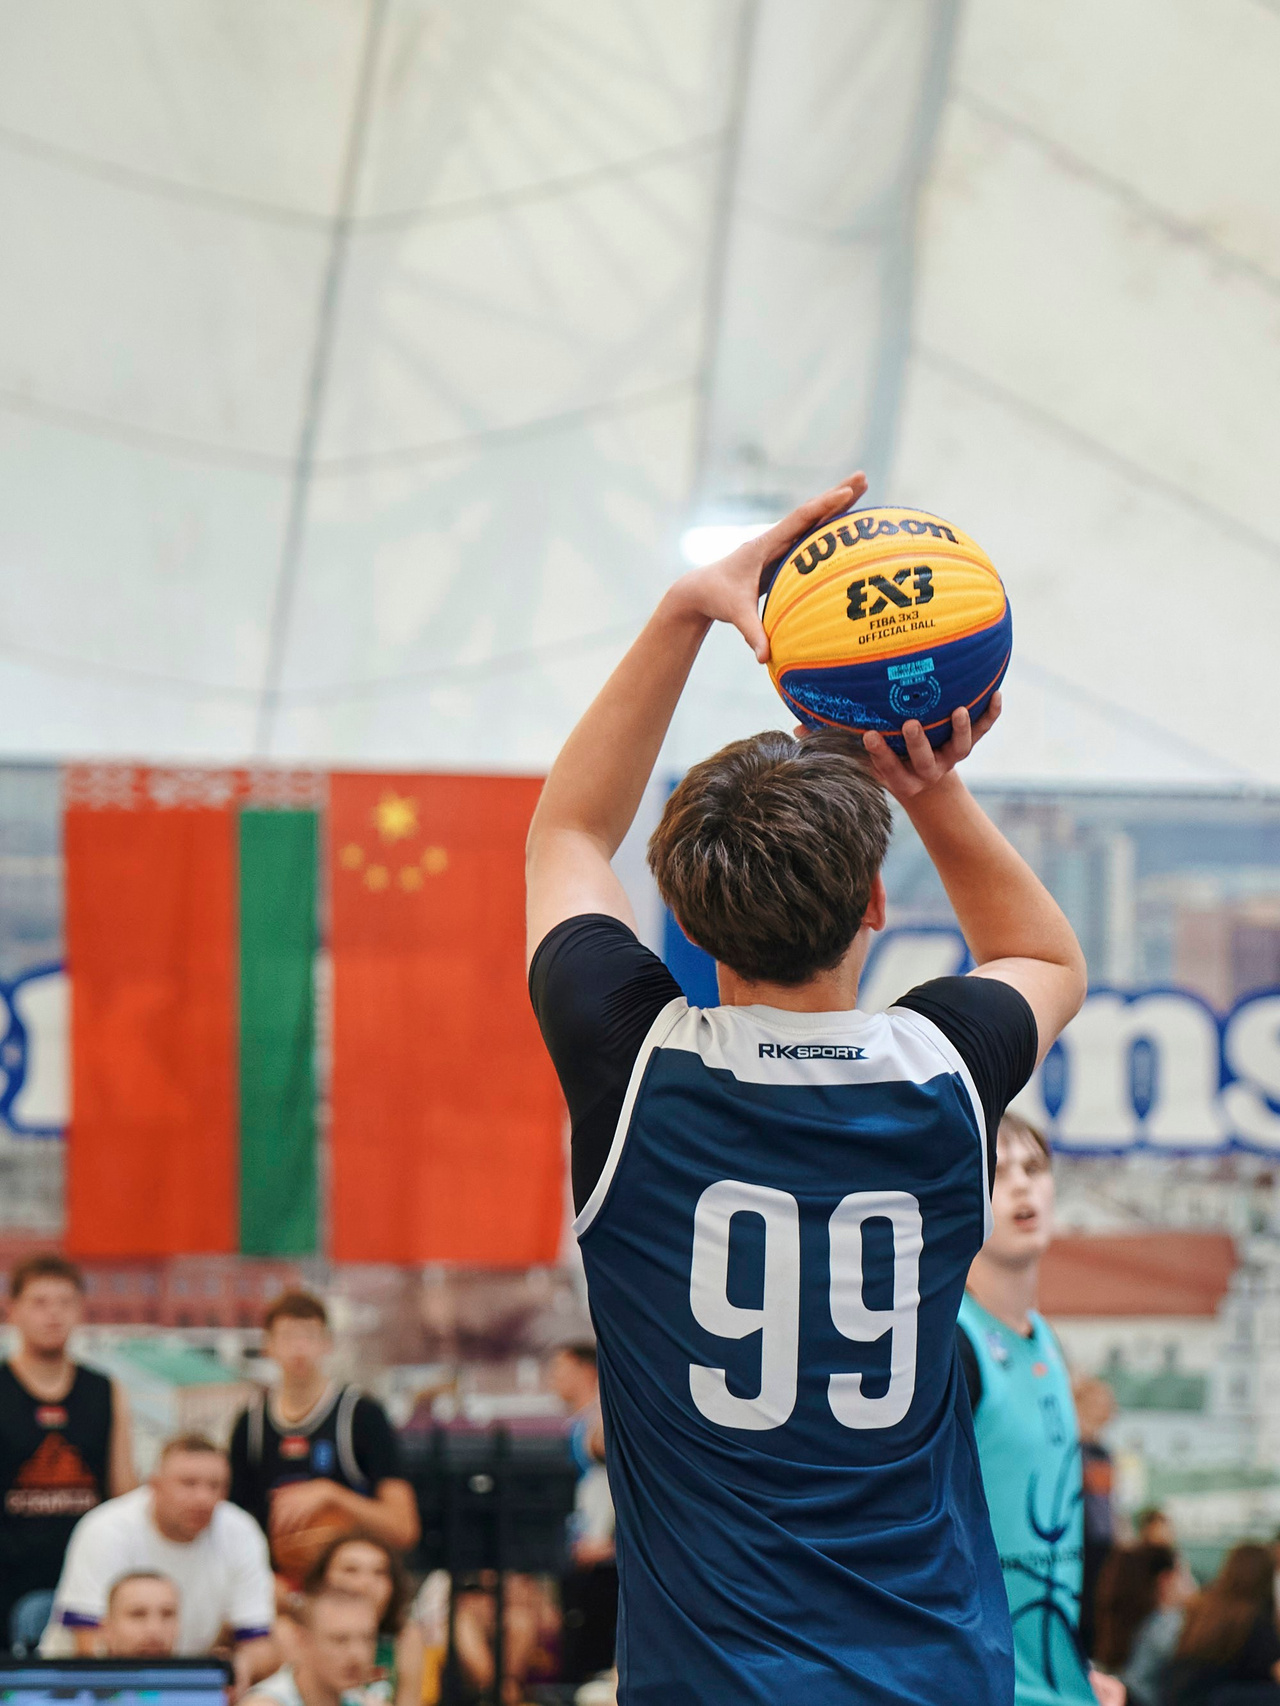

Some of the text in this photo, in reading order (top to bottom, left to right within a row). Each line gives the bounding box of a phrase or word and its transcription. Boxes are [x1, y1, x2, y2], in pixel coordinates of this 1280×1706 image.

[791, 517, 959, 575] Wilson
[858, 619, 936, 645] OFFICIAL BALL
[869, 616, 896, 630] FIBA
[689, 1180, 924, 1431] 99
